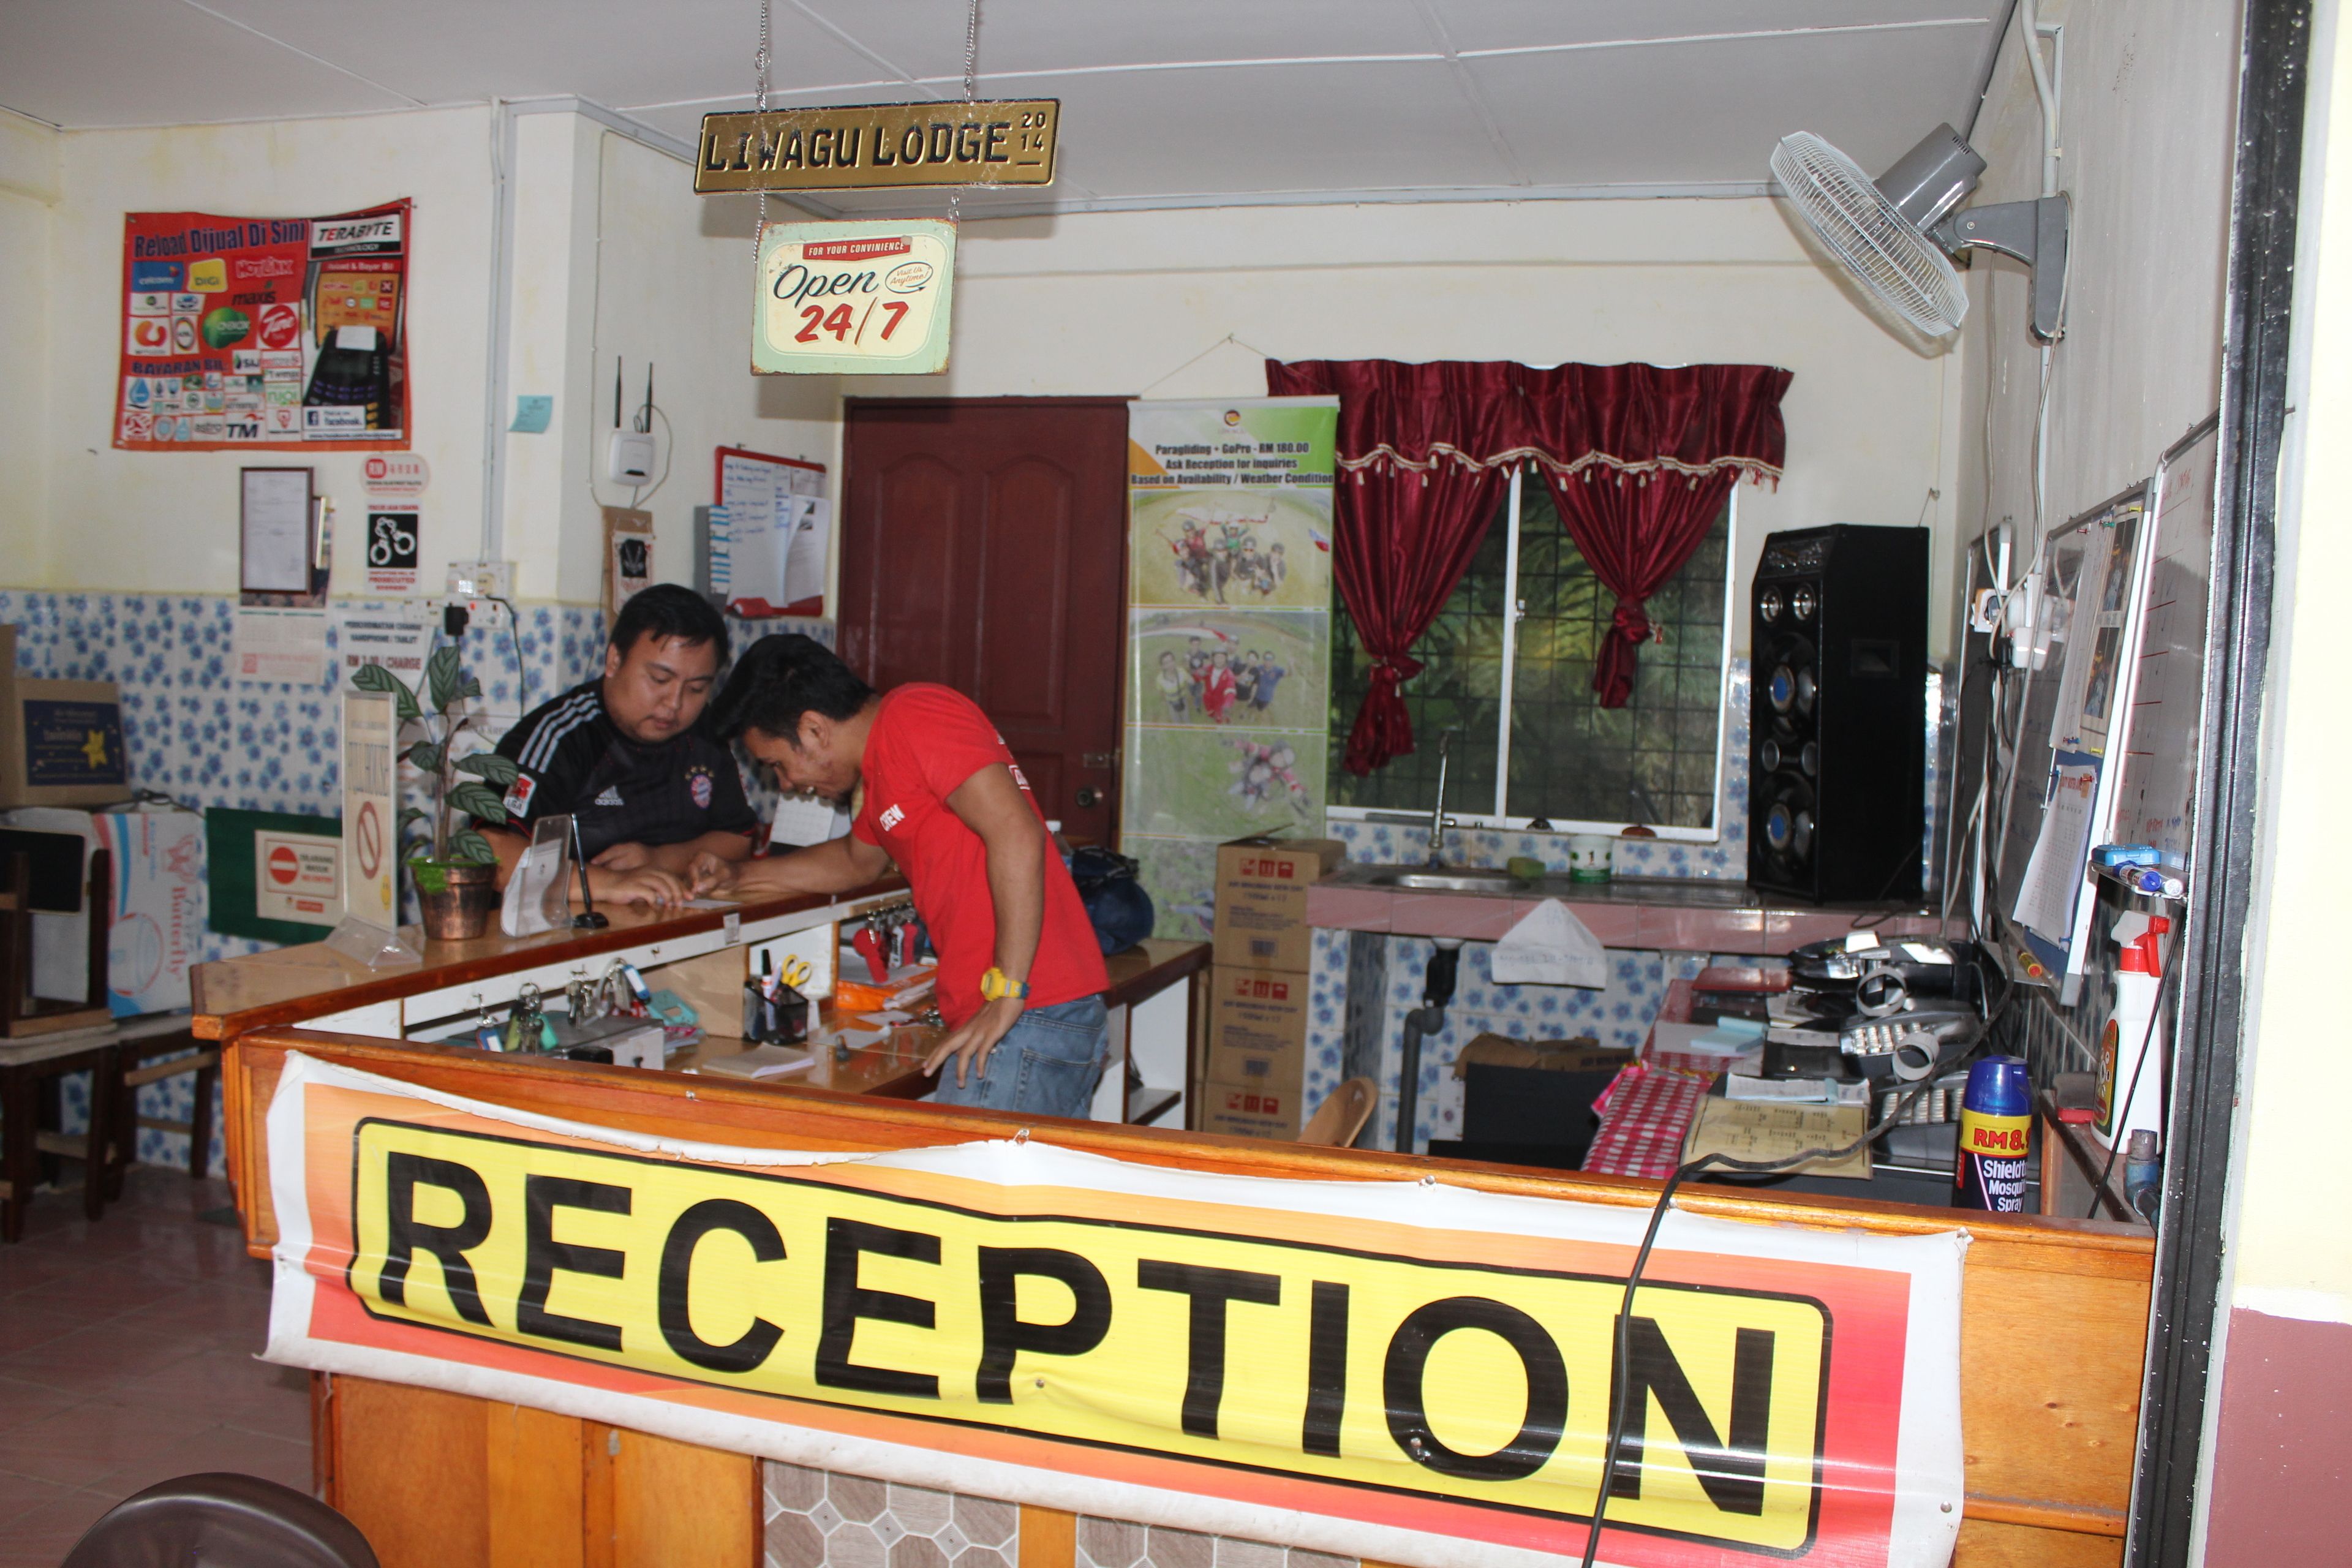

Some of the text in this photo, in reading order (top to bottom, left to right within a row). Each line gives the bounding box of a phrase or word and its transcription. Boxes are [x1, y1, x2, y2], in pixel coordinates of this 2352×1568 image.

[1020, 111, 1046, 130] 20
[705, 121, 1015, 172] LIWAGU LODGE
[1021, 133, 1044, 152] 14
[134, 219, 305, 257] Reload Dijual Di Sini
[318, 221, 394, 241] TERABYTE
[808, 241, 905, 256] FOR YOUR CONVINIENCE
[896, 268, 913, 277] Visit
[773, 264, 880, 309] Open
[232, 291, 276, 306] maxis
[794, 296, 910, 346] 24/7
[227, 423, 259, 439] TM
[1156, 444, 1212, 456] Paragliding
[1223, 443, 1251, 454] GoPro
[1259, 442, 1274, 453] RM
[1277, 442, 1309, 453] 180.00
[1166, 458, 1298, 470] Ask Reception for Inquiries
[1131, 474, 1161, 484] Based
[1163, 475, 1175, 484] on
[1177, 473, 1232, 484] Availability
[1241, 473, 1283, 484] Weather
[595, 797, 624, 806] adidas
[879, 803, 905, 832] CREW
[165, 886, 187, 976] Butterfly
[1983, 1159, 2027, 1179] Shieldt
[1997, 1196, 2022, 1213] Spray
[379, 1151, 1776, 1517] RECEPTION
